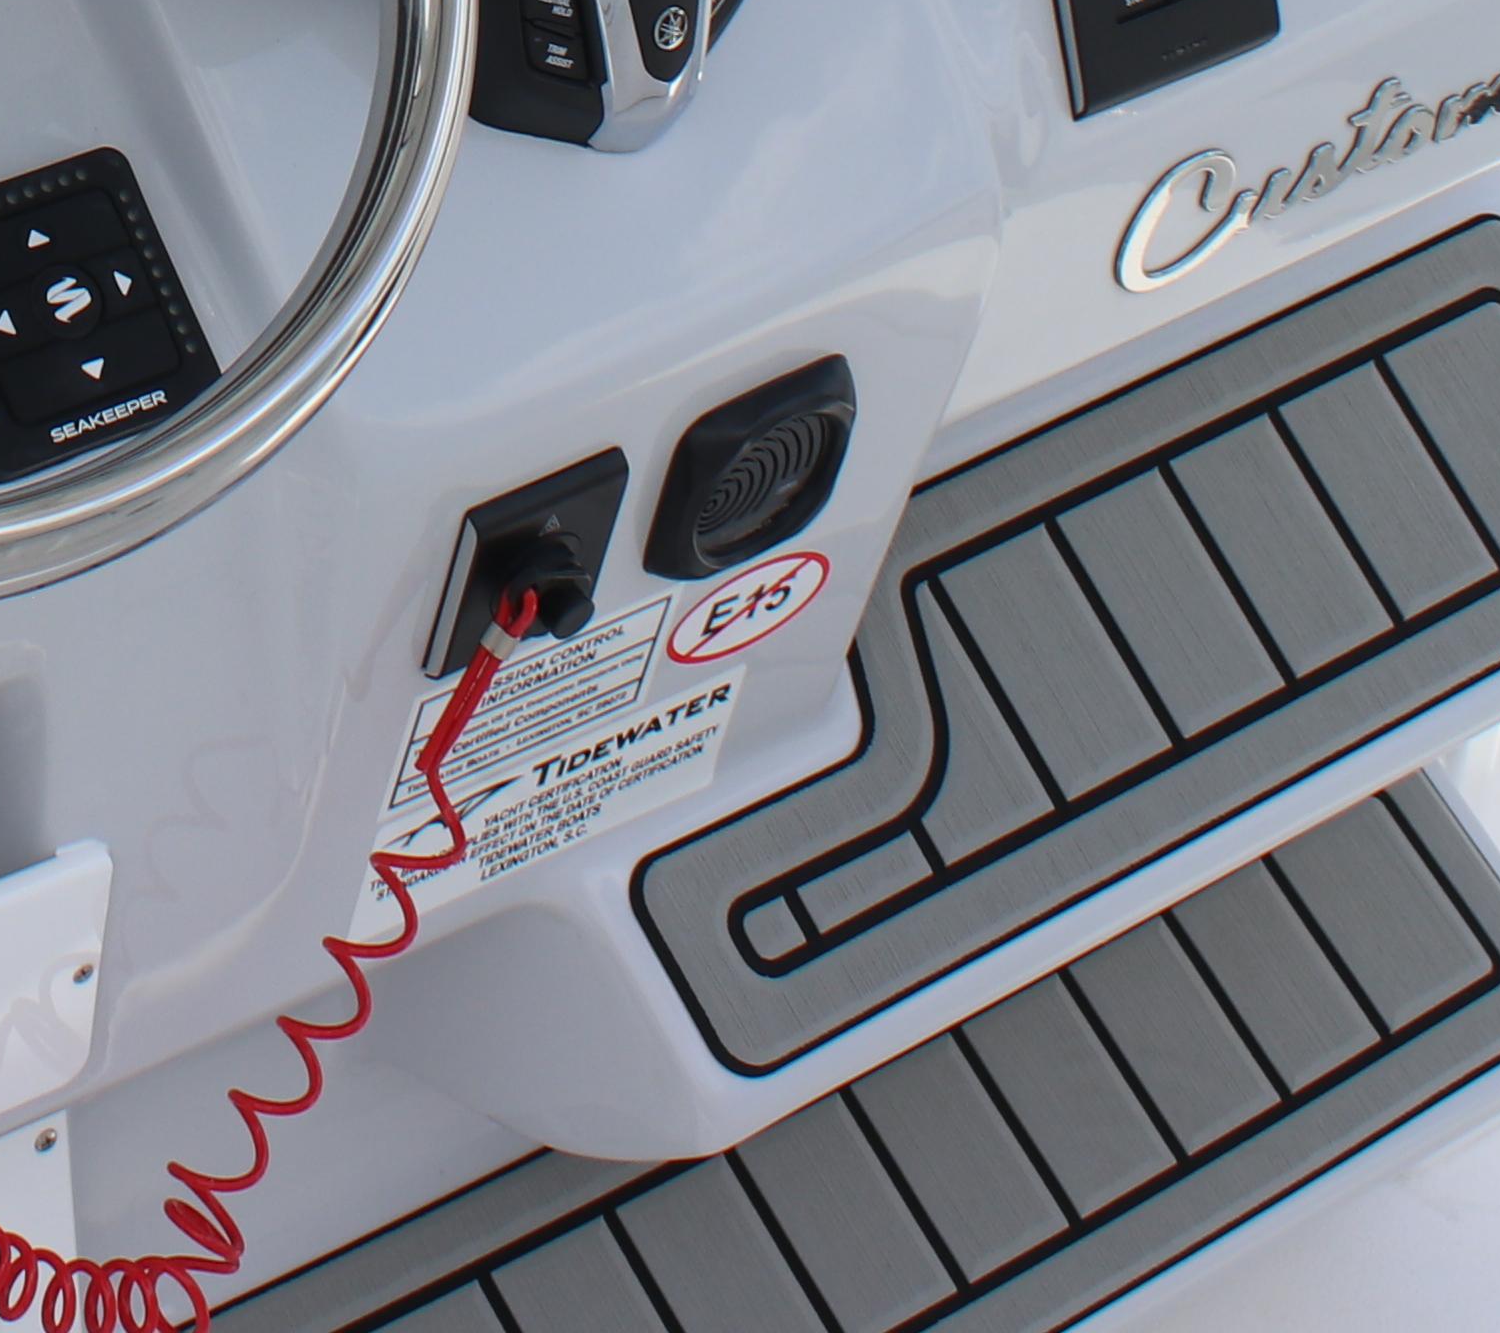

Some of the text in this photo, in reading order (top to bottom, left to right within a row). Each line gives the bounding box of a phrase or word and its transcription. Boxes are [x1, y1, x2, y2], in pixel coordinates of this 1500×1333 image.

[50, 389, 168, 444] SEAKEEPER
[701, 573, 792, 636] E15
[480, 650, 598, 708] INFORMATION
[491, 659, 546, 690] SSION
[549, 625, 626, 665] CONTROL
[452, 722, 510, 754] Certified
[513, 684, 600, 727] Components
[533, 682, 731, 787] TIDEWATER
[470, 831, 516, 860] EFFECT
[518, 821, 537, 835] ON
[567, 796, 600, 816] DATE
[600, 786, 618, 800] OF
[619, 744, 705, 791] CERTIFICATION
[483, 756, 623, 827] YACHT CERTIFICATION
[503, 811, 534, 831] WITH
[587, 765, 628, 793] COAST
[629, 746, 673, 772] GUARD
[674, 724, 720, 753] SAFETY
[478, 803, 602, 868] TIDEWATER BOATS
[480, 839, 559, 881] LEXINGTON,
